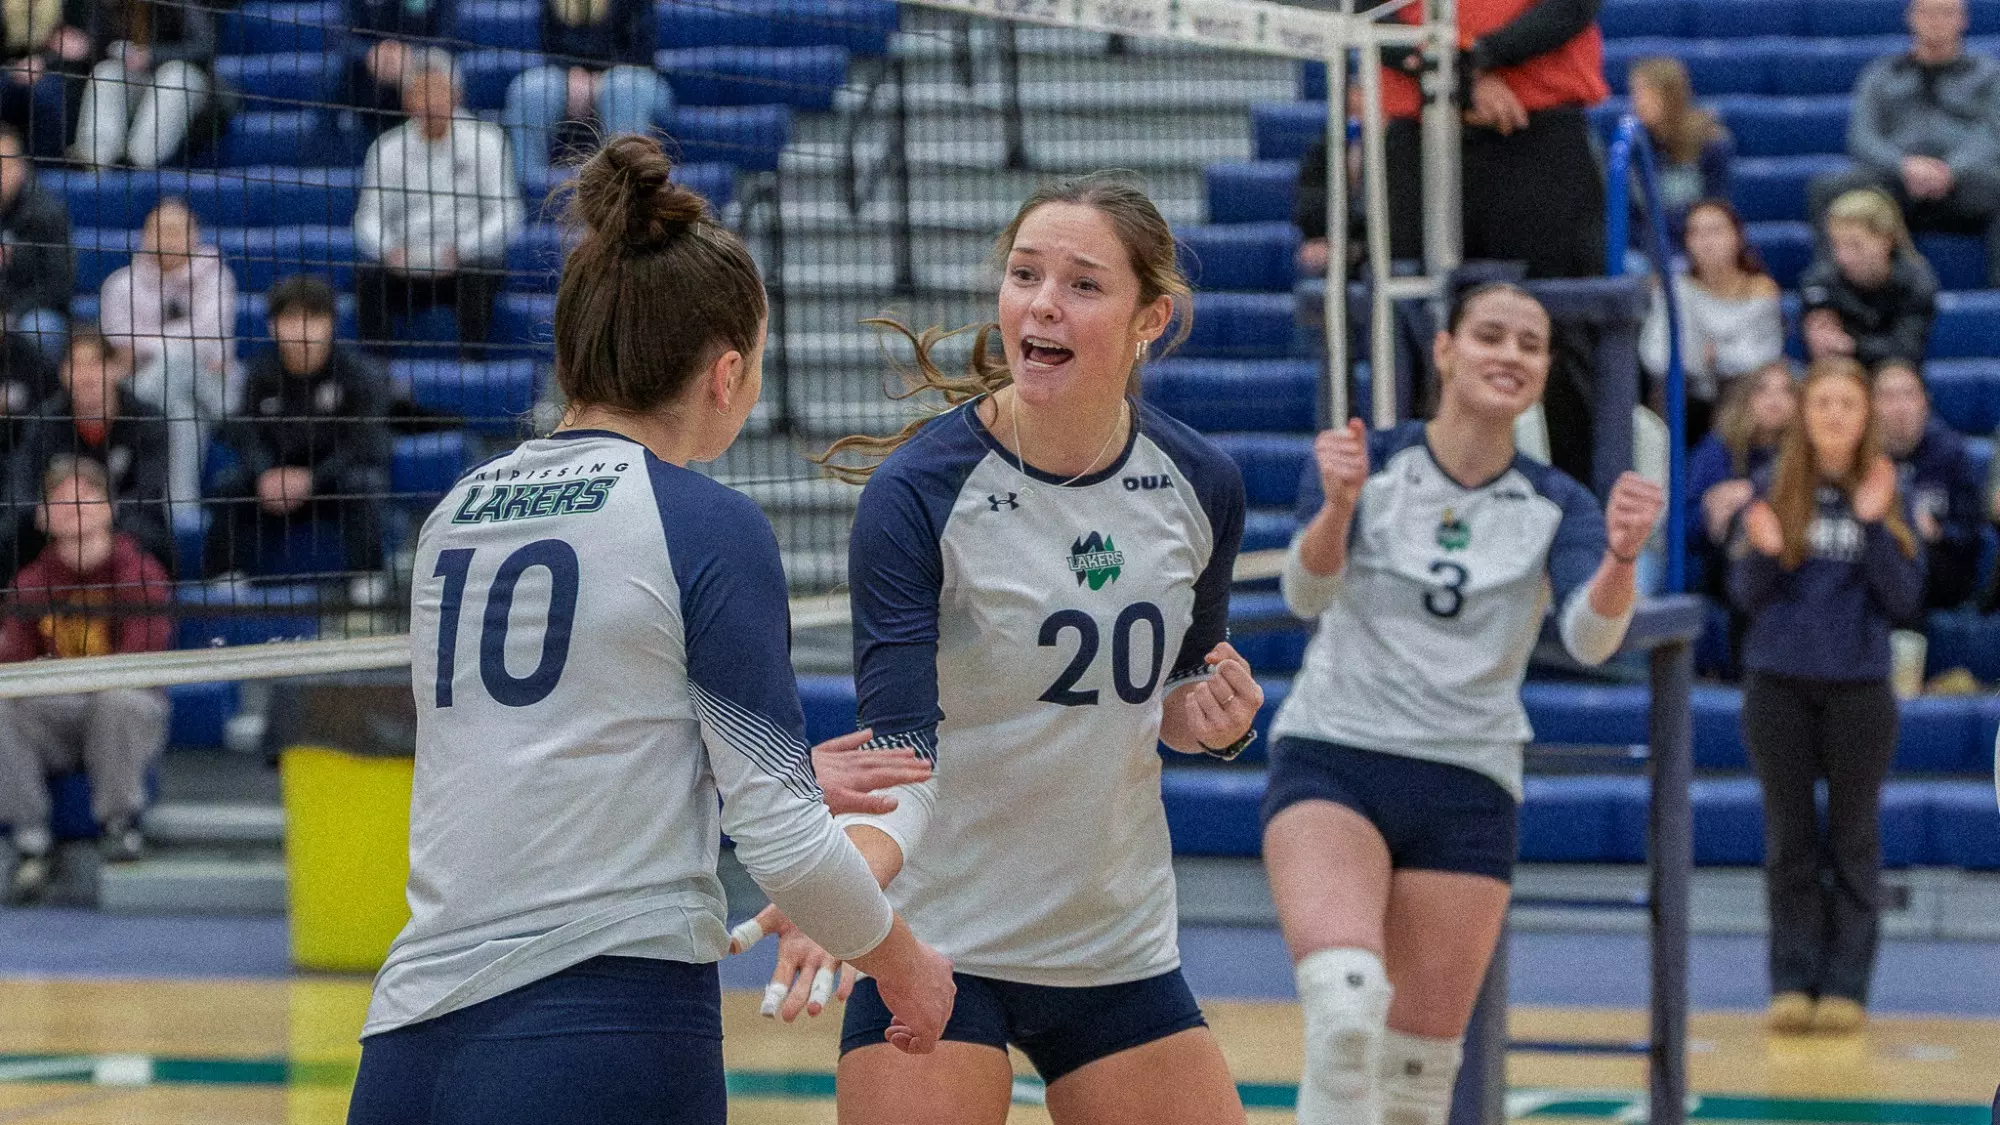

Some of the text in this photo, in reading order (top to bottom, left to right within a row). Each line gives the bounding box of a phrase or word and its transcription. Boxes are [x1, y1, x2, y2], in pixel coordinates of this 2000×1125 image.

[451, 475, 620, 524] LAKERS
[1122, 474, 1174, 491] OUA
[1066, 550, 1125, 572] LAKERS
[1424, 560, 1468, 618] 3
[432, 538, 579, 709] 10
[1037, 601, 1166, 707] 20
